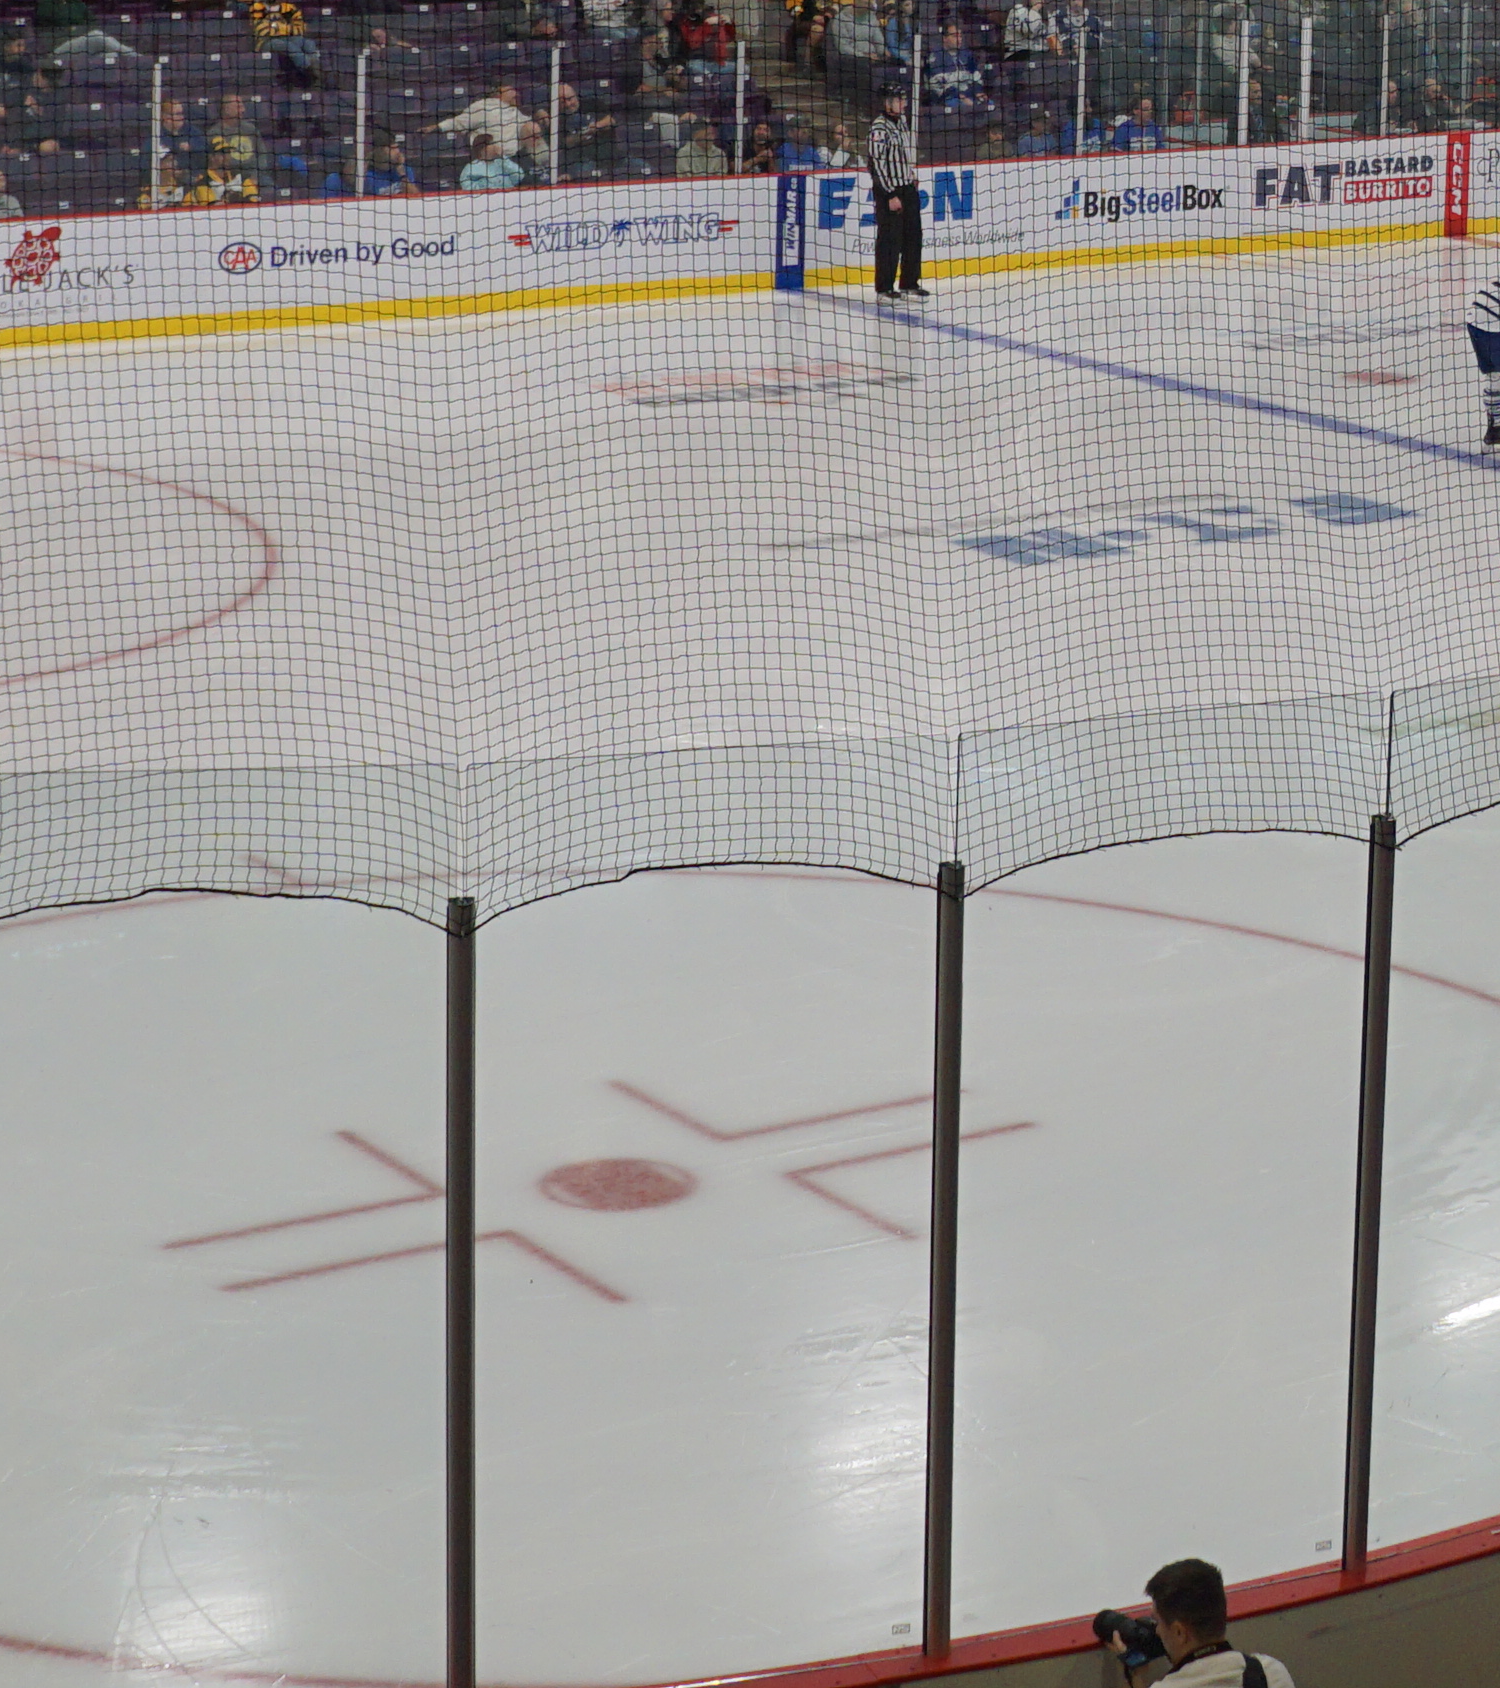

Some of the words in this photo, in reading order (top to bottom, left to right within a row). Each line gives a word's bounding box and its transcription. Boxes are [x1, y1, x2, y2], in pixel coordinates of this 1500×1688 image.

[1344, 154, 1434, 177] BASTARD
[1082, 185, 1224, 223] BigSteelBox
[1253, 166, 1341, 210] FAT
[1344, 177, 1431, 202] BURRITO
[526, 222, 606, 254] WILD
[633, 213, 720, 246] WING
[224, 246, 259, 271] CAA
[270, 240, 349, 268] Driven
[356, 240, 384, 267] by
[391, 235, 456, 259] Good
[43, 264, 136, 291] JACK'S
